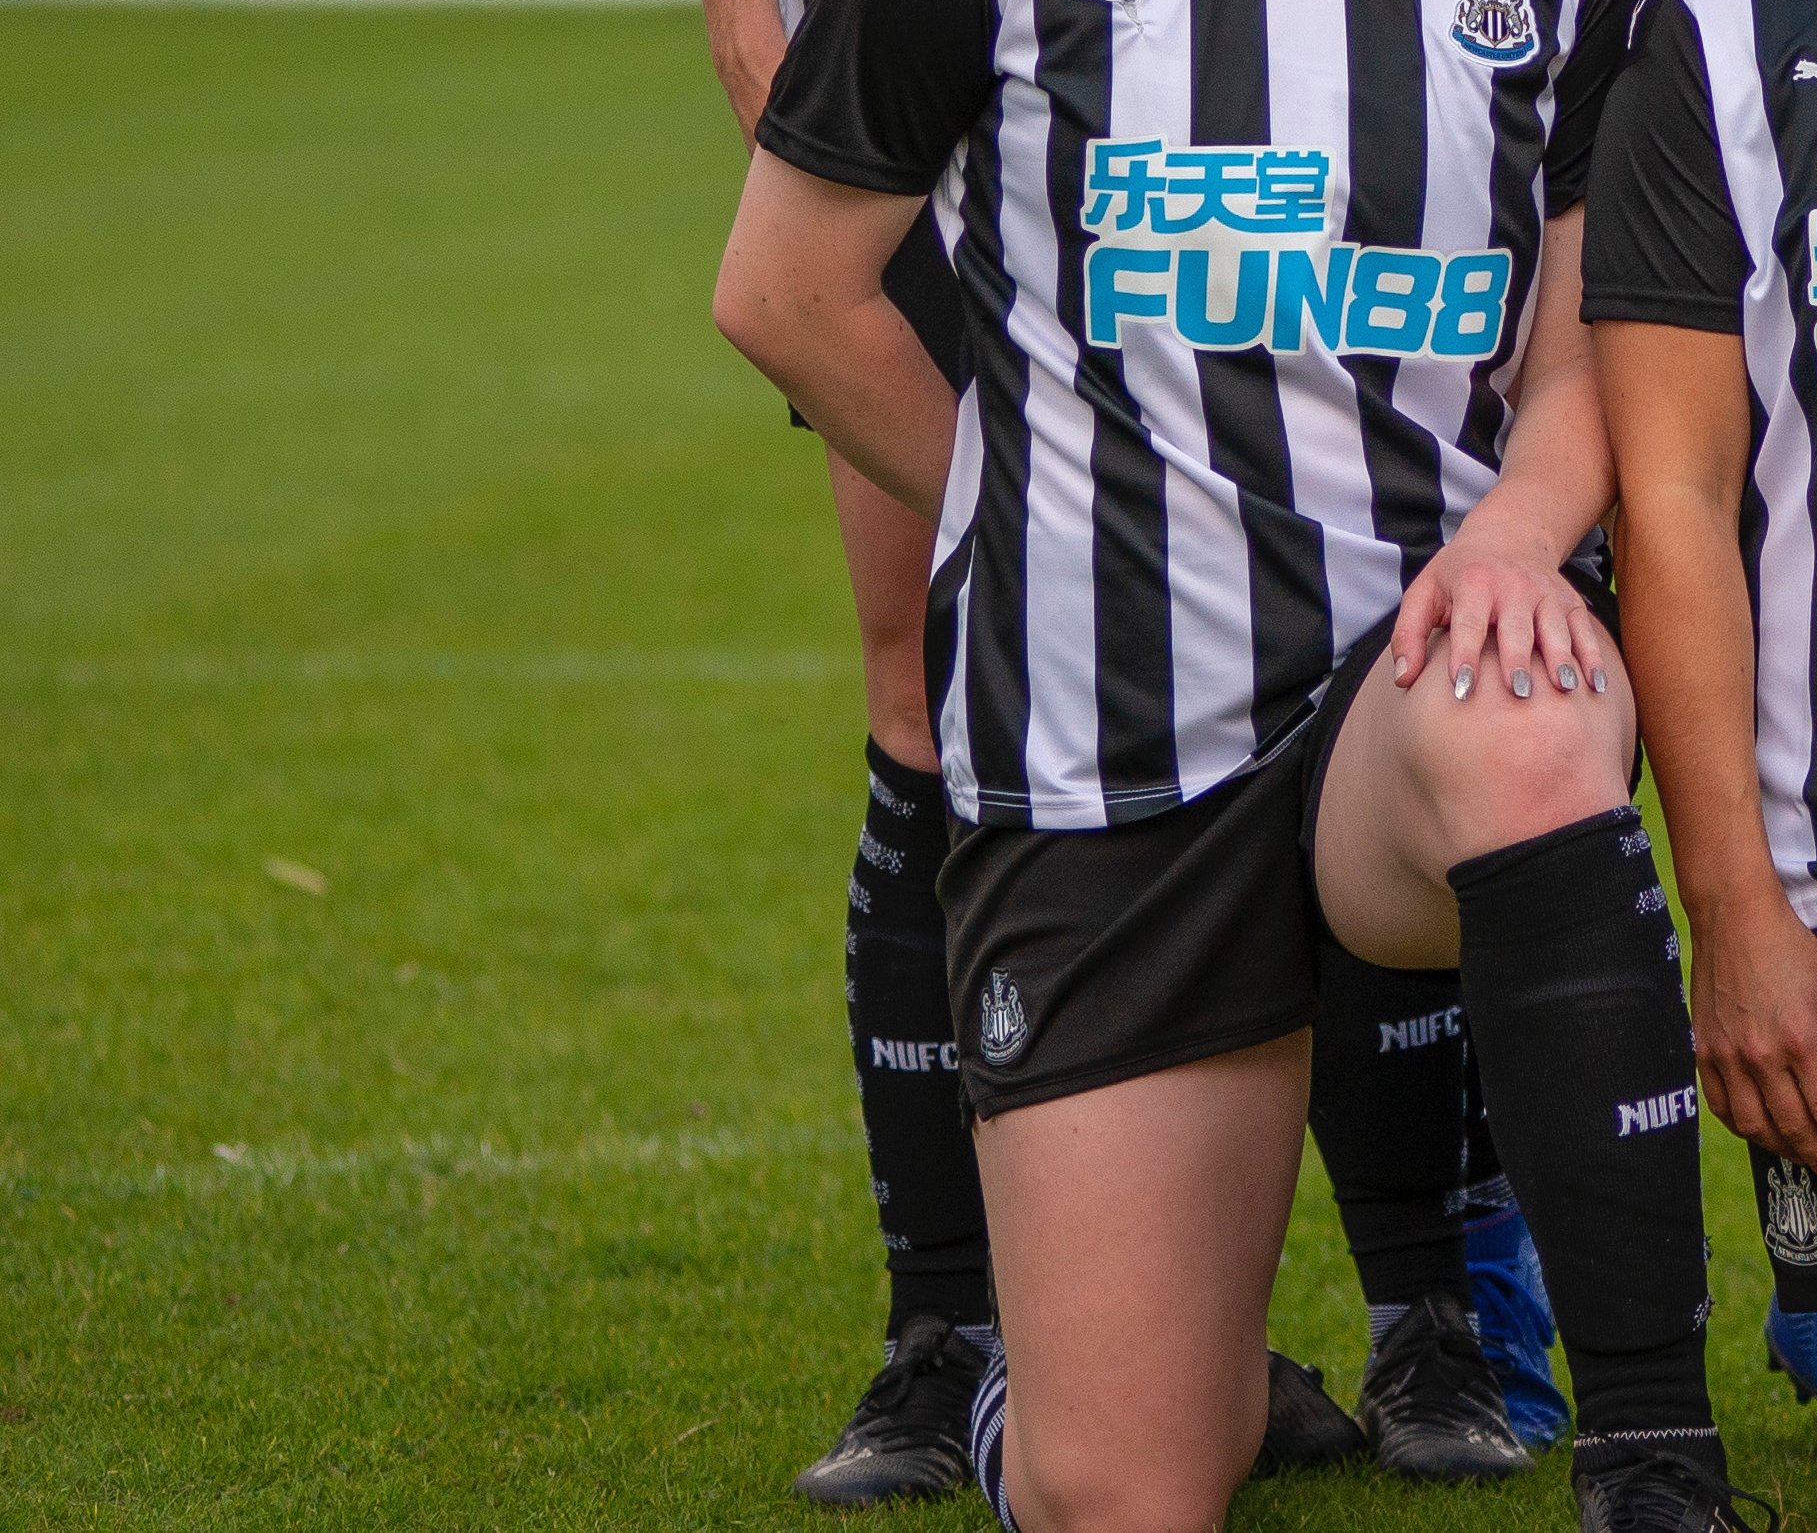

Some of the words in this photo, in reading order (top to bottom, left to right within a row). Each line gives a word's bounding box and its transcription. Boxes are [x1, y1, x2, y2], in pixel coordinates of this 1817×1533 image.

[1084, 139, 1330, 234] 乐天堂
[1088, 246, 1511, 355] FUN88
[870, 1036, 959, 1072] NUFC
[1379, 1004, 1462, 1053] NUFC
[1617, 1085, 1696, 1137] NUFC
